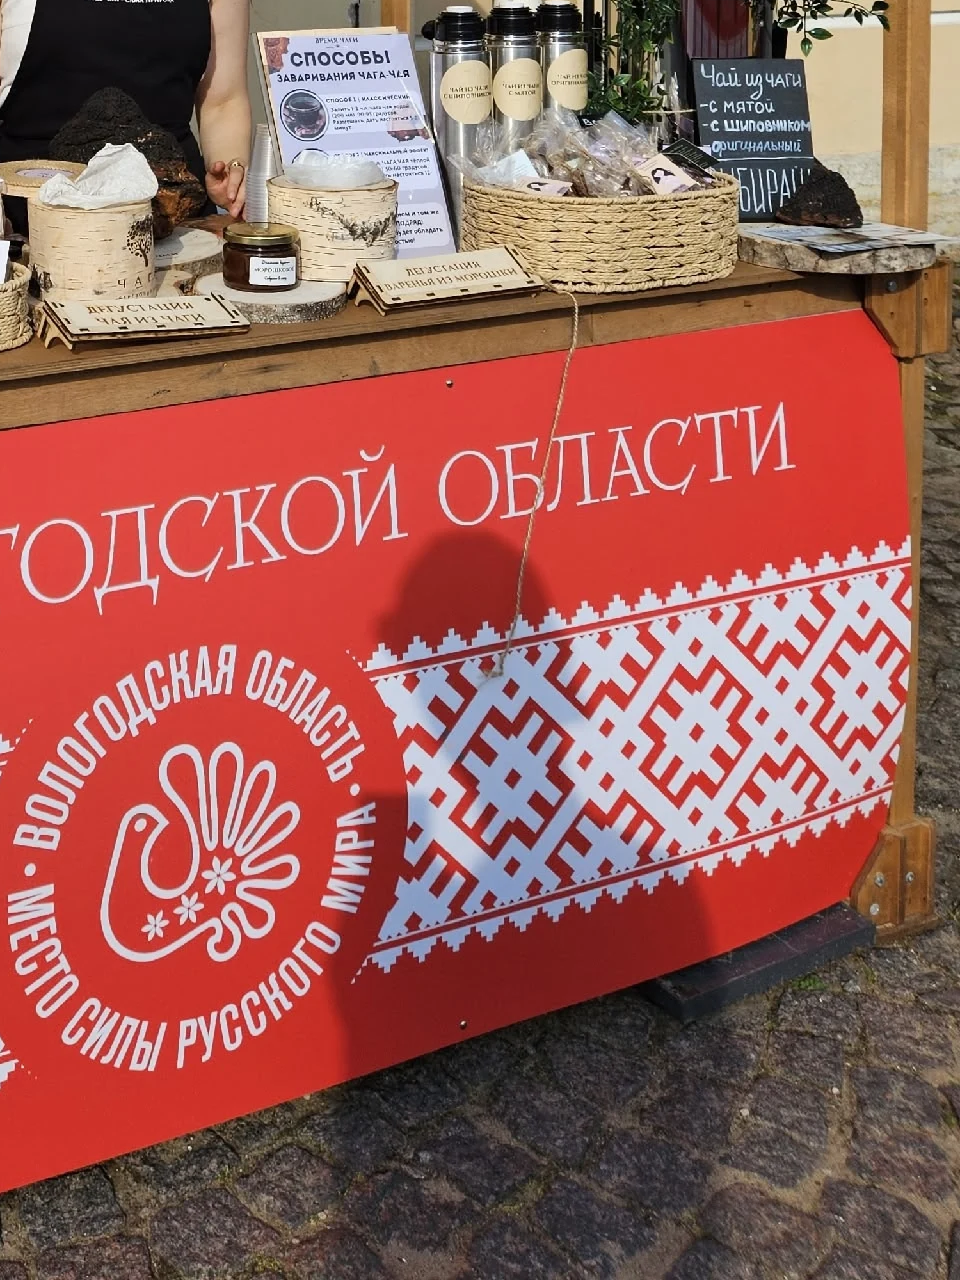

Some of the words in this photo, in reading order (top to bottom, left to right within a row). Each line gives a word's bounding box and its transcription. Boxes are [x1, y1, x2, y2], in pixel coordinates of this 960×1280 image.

[290, 50, 391, 67] СПОСОБЫ
[277, 71, 356, 83] ЗАВАРИВАНИЯ
[358, 69, 411, 80] ЧАГА-ЧАЯ
[700, 63, 741, 87] Чай
[745, 73, 763, 100] из
[384, 278, 436, 291] ВАРЕНЬЯ
[436, 277, 453, 285] ИЗ
[454, 267, 518, 282] МОРОШКИ
[405, 261, 482, 277] ДЕГУСТАЦИЯ
[86, 302, 195, 315] ДЕГУСТАЦИЯ
[96, 316, 132, 325] ЧАЯ
[134, 315, 158, 324] ИЗ
[160, 313, 206, 323] ЧАГИ
[438, 402, 797, 527] ОБЛАСТИ
[13, 644, 238, 851] ВОЛОГОДСКАЯ
[245, 649, 366, 783] ОБЛАСТЬ
[7, 883, 80, 1019] МЕСТО
[60, 997, 168, 1072] СИЛЫ
[176, 921, 341, 1069] РУССКОГО
[320, 802, 377, 913] МИРА
